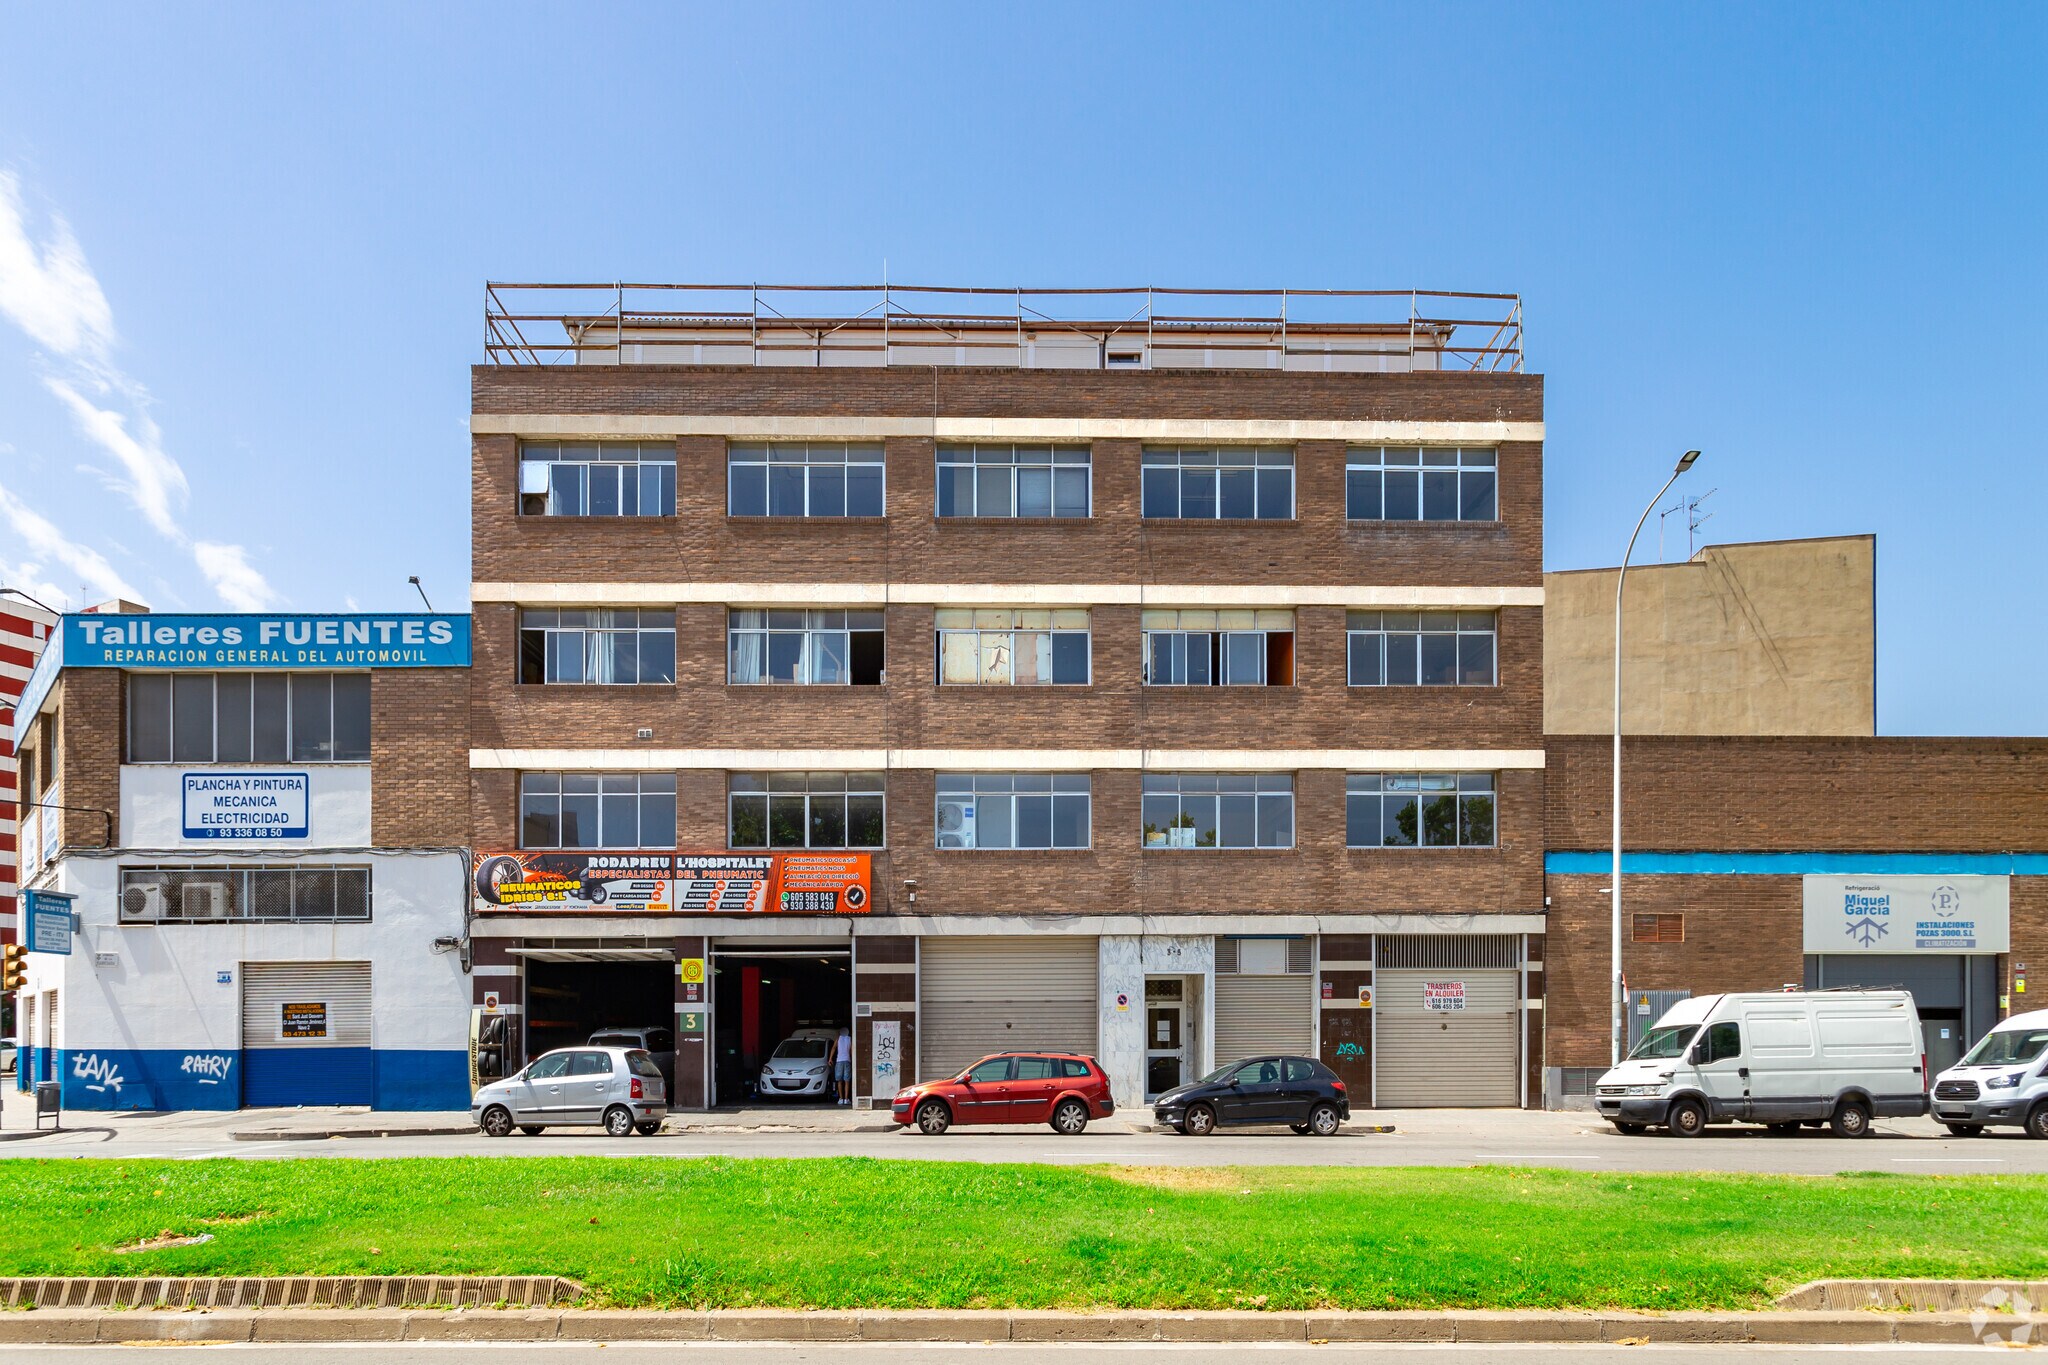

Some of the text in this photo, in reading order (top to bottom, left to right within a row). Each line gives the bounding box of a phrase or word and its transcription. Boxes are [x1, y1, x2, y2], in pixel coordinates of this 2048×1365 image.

[79, 620, 452, 645] Talleres FUENTES
[104, 650, 426, 662] REPARACION GENERAL DEL AUTOMOVIL
[188, 780, 302, 790] PLANCHA Y PINTURA
[214, 796, 277, 807] MECANICA
[202, 813, 289, 824] ELECTRICIDAD
[220, 828, 282, 837] 93 336 08 50
[588, 857, 773, 868] RODAPREU L'HOSPITALET
[588, 870, 764, 879] ESPECIALISTAS DEL PNEUMATIC
[500, 880, 581, 893] NEUMATICOS
[790, 892, 833, 901] 605 583 043
[35, 903, 69, 913] FUENTES
[1845, 903, 1890, 915] García
[686, 1014, 696, 1028] 3
